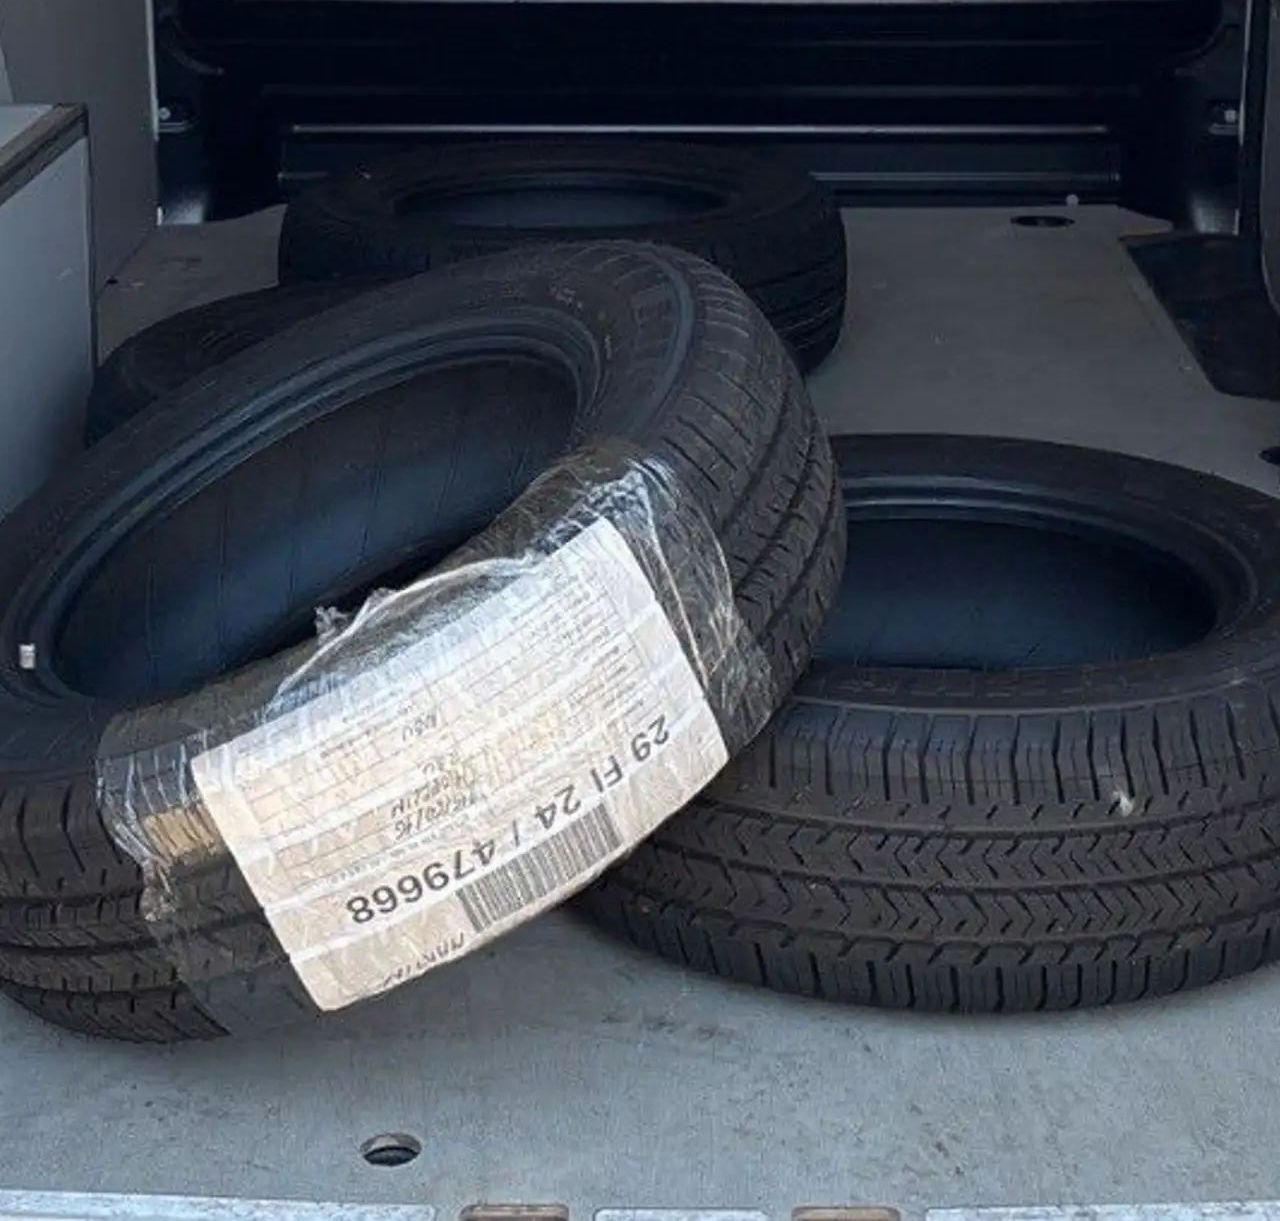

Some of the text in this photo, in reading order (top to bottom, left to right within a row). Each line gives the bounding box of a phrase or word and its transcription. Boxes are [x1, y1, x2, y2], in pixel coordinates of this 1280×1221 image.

[631, 714, 670, 762] 29
[590, 754, 626, 793] FI
[534, 784, 582, 830] 24
[345, 838, 496, 925] 479668
